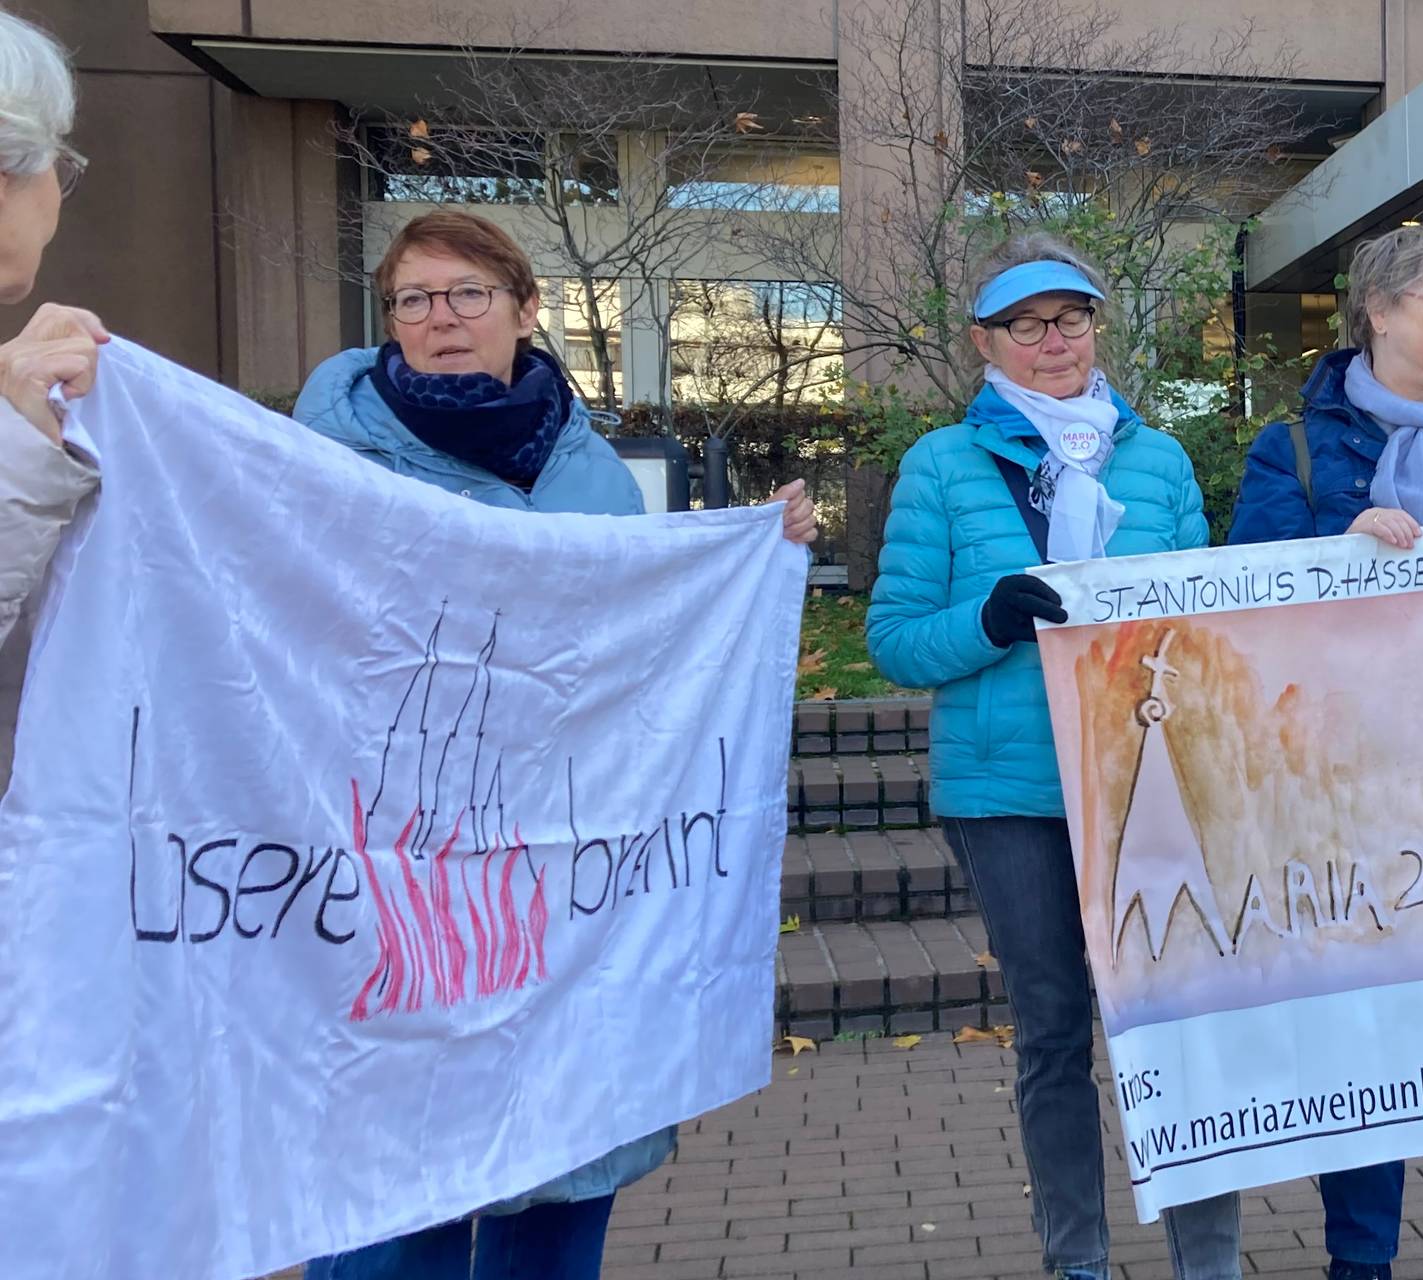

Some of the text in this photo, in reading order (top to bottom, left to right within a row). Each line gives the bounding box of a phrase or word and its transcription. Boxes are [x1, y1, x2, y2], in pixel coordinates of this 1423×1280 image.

[1063, 432, 1097, 441] MARIA
[1070, 441, 1090, 450] 2.0
[1112, 858, 1394, 968] MARIA
